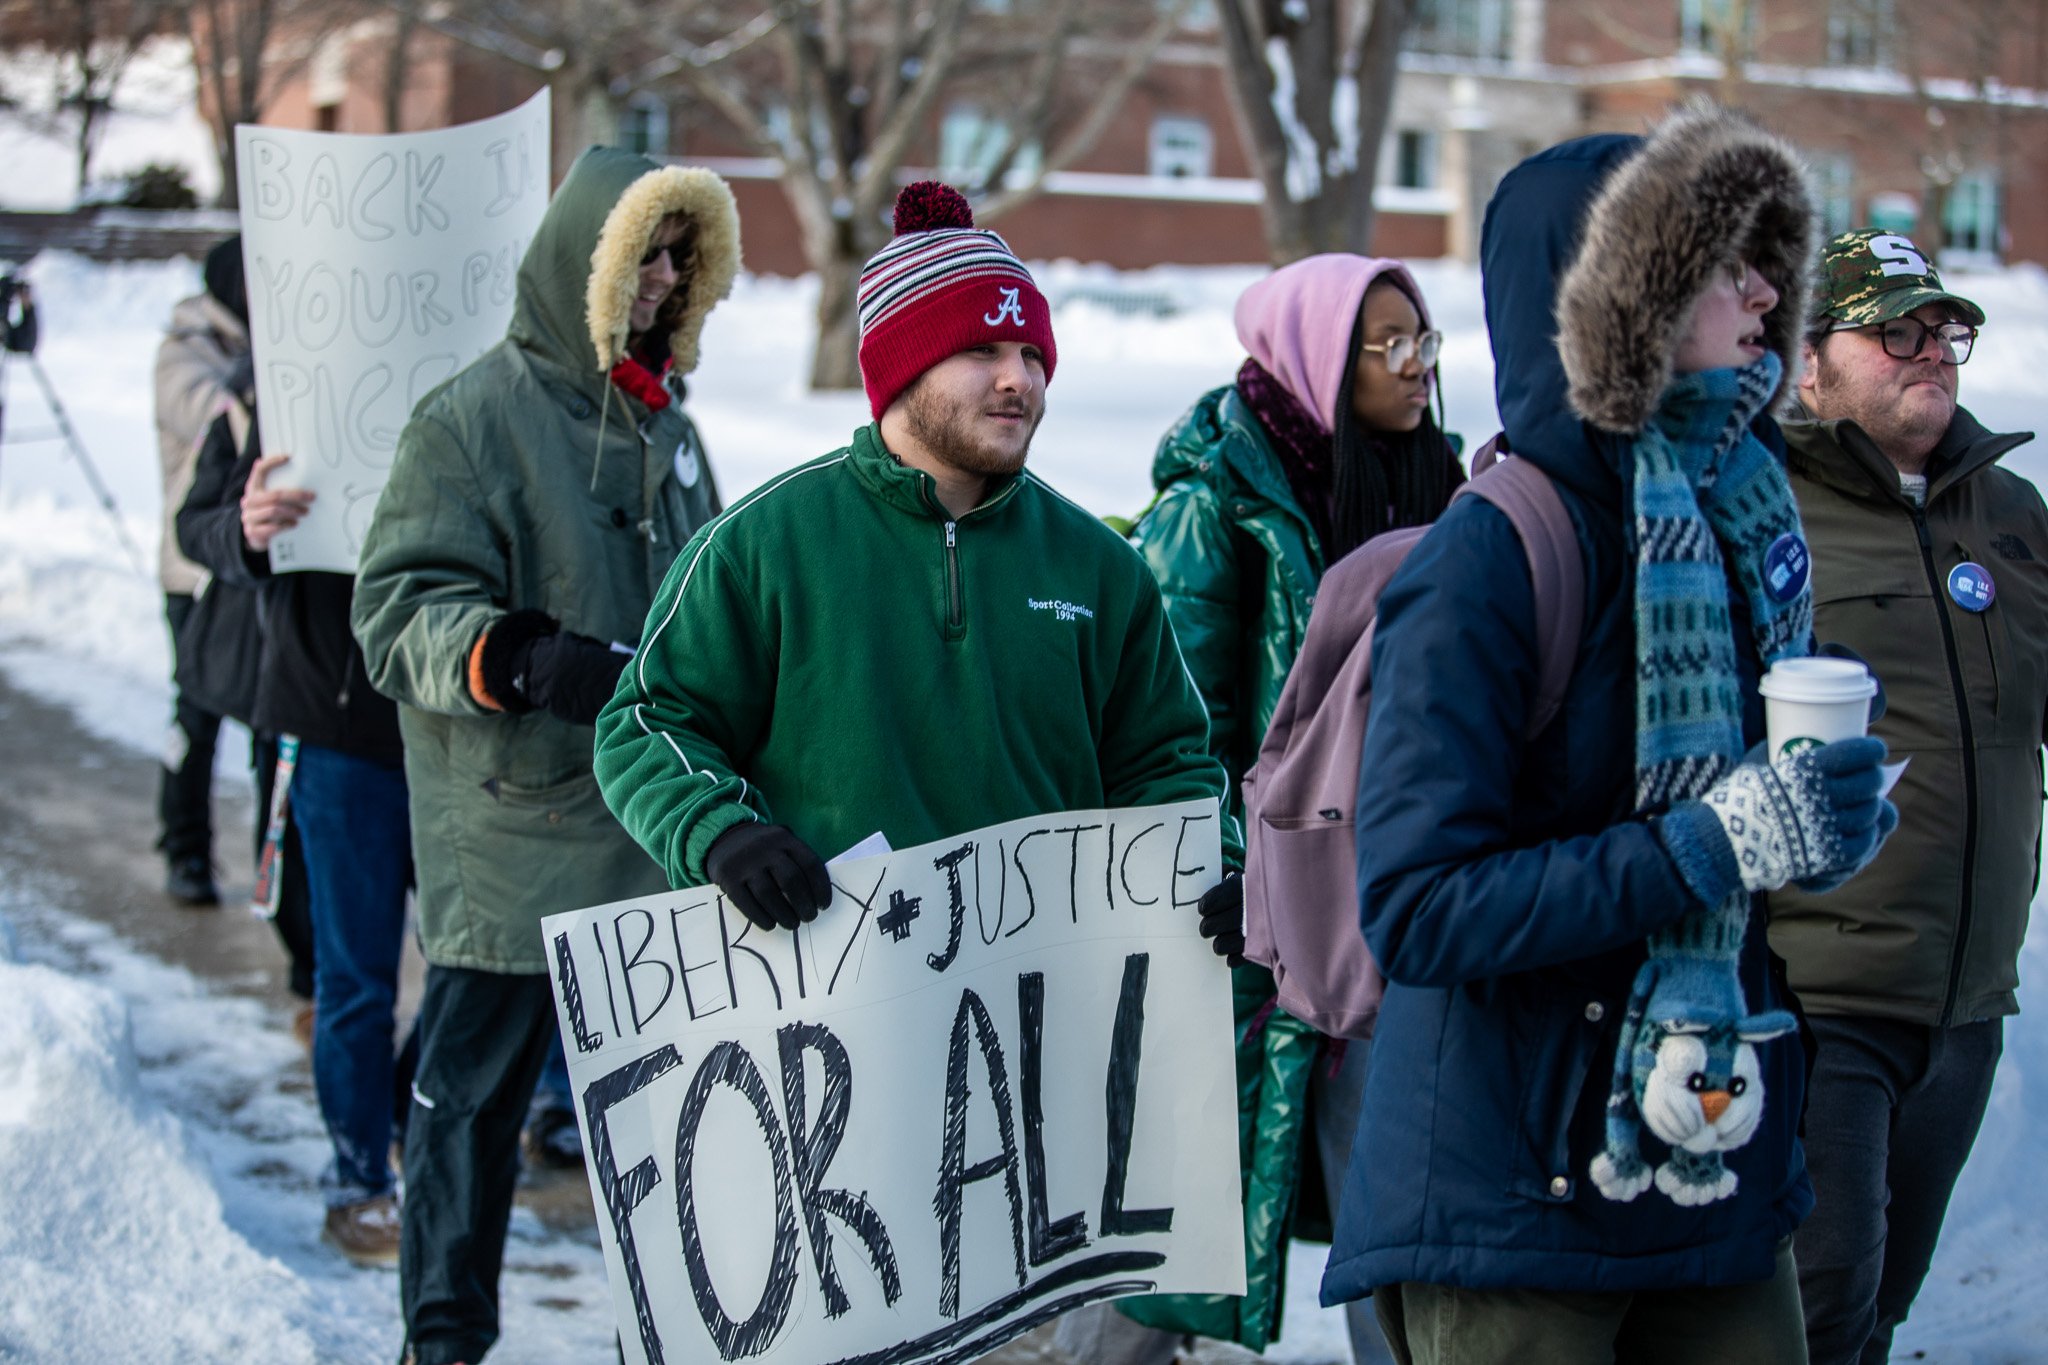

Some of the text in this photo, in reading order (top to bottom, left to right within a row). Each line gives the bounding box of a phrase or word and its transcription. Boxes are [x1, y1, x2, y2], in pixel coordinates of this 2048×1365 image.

[248, 138, 450, 242] BACK
[256, 240, 521, 351] YOUR PE
[983, 286, 1026, 327] A
[1868, 235, 1928, 278] S
[1055, 609, 1076, 621] 1994
[926, 813, 1213, 972] JUSTICE
[581, 951, 1175, 1365] FOR ALL
